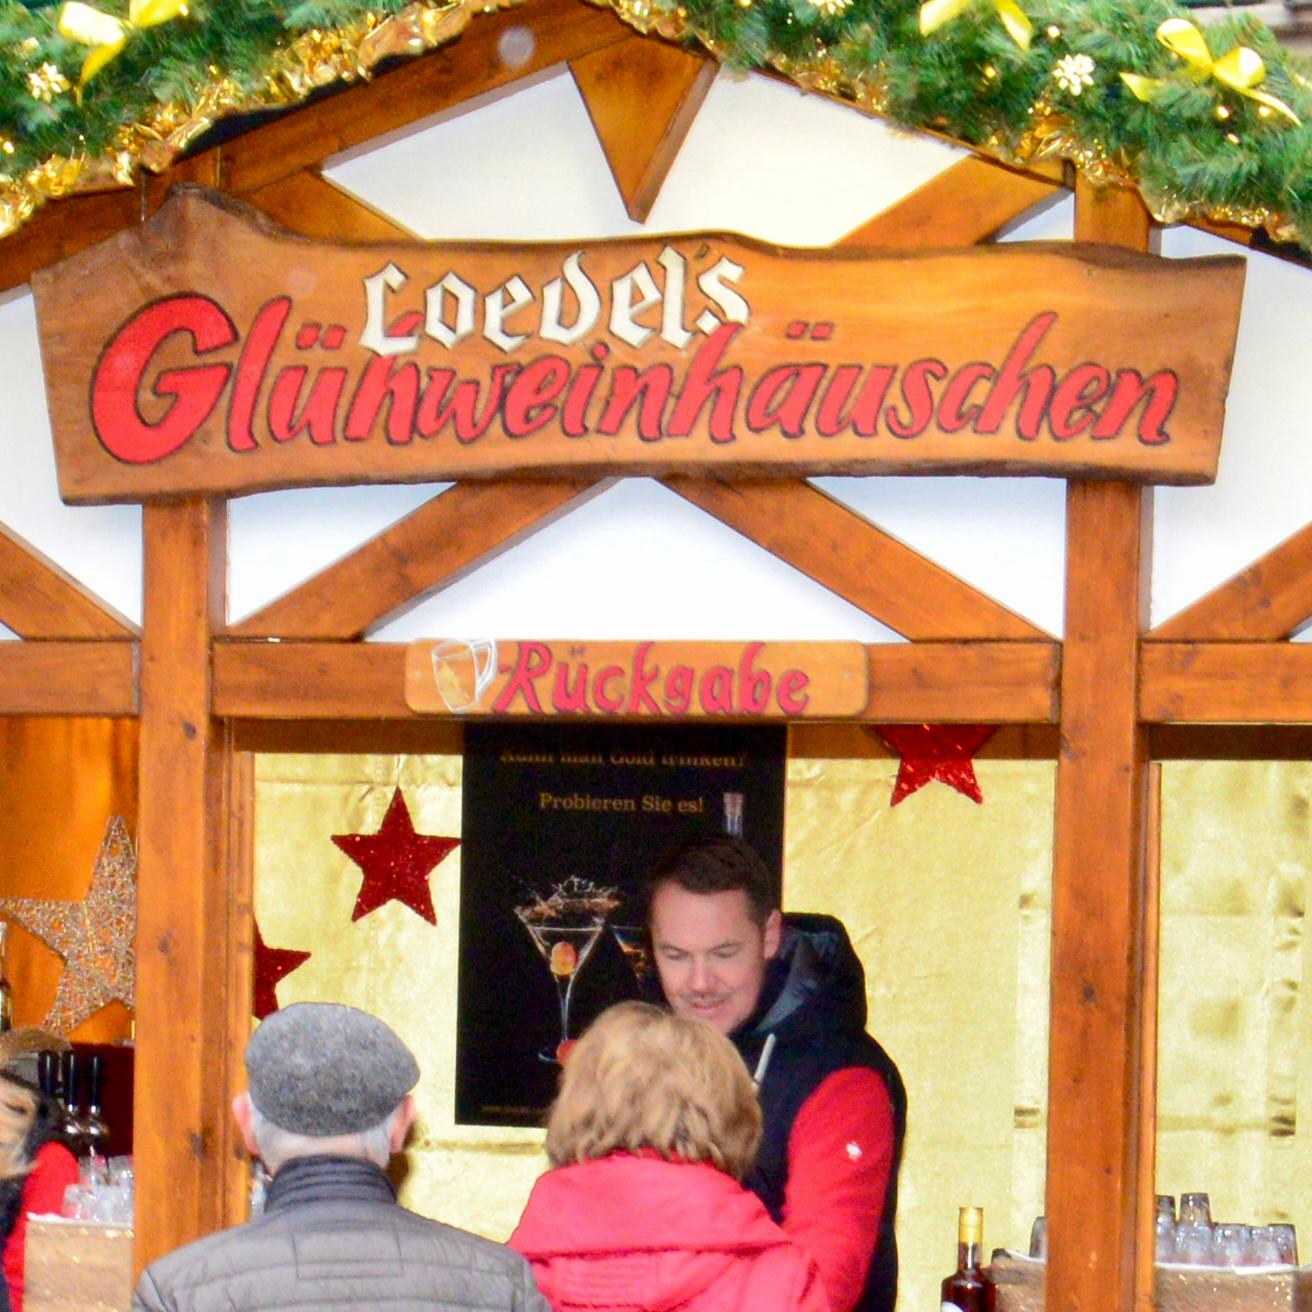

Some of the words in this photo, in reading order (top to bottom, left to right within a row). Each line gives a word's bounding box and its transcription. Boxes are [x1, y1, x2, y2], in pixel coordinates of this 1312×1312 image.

[92, 292, 1180, 466] Glühweinhäuschen
[489, 640, 811, 715] Rückgabe
[539, 791, 635, 811] Probieren
[641, 793, 673, 813] Sie
[676, 796, 705, 813] es!
